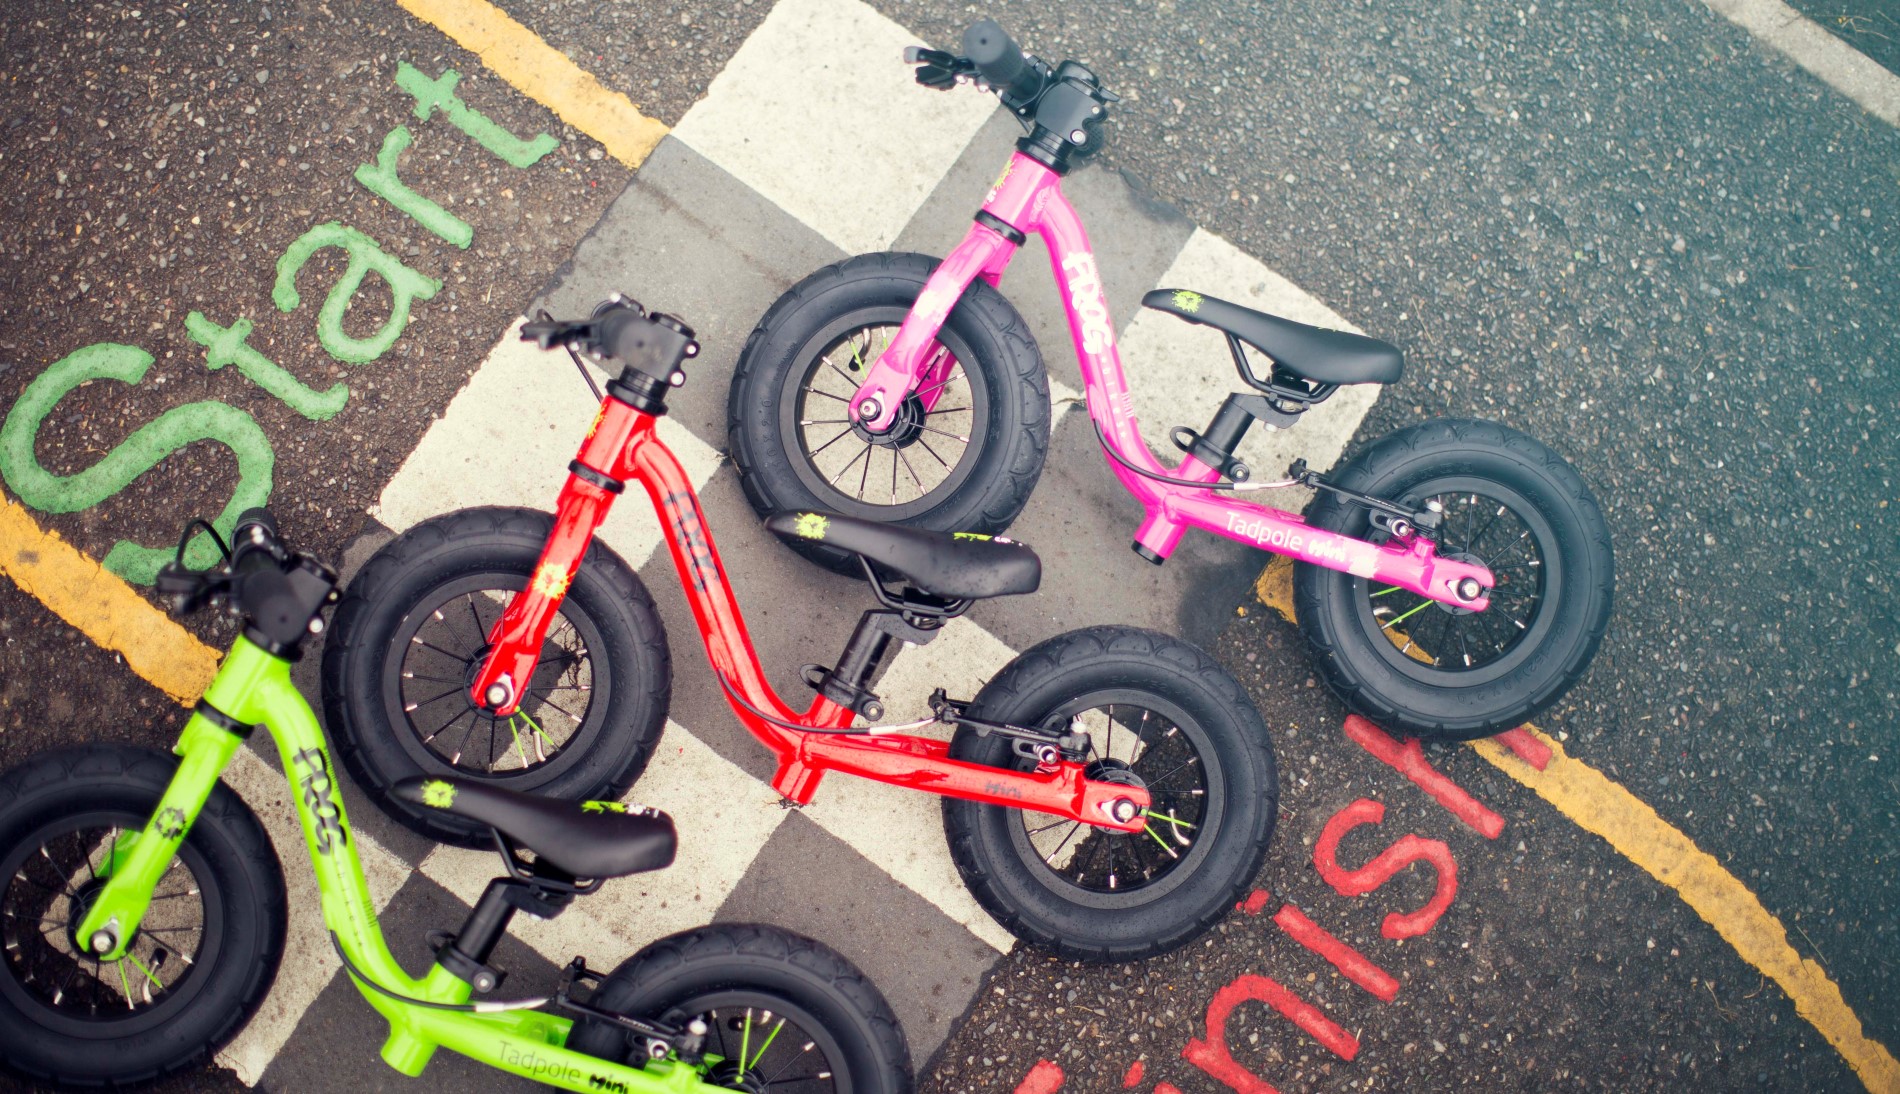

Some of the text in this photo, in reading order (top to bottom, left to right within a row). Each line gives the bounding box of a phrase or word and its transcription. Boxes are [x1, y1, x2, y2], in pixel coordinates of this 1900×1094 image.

[0, 60, 559, 585] Start
[1225, 509, 1303, 551] Tadpole
[1013, 714, 1553, 1094] nish
[499, 1039, 581, 1084] Tadpole
